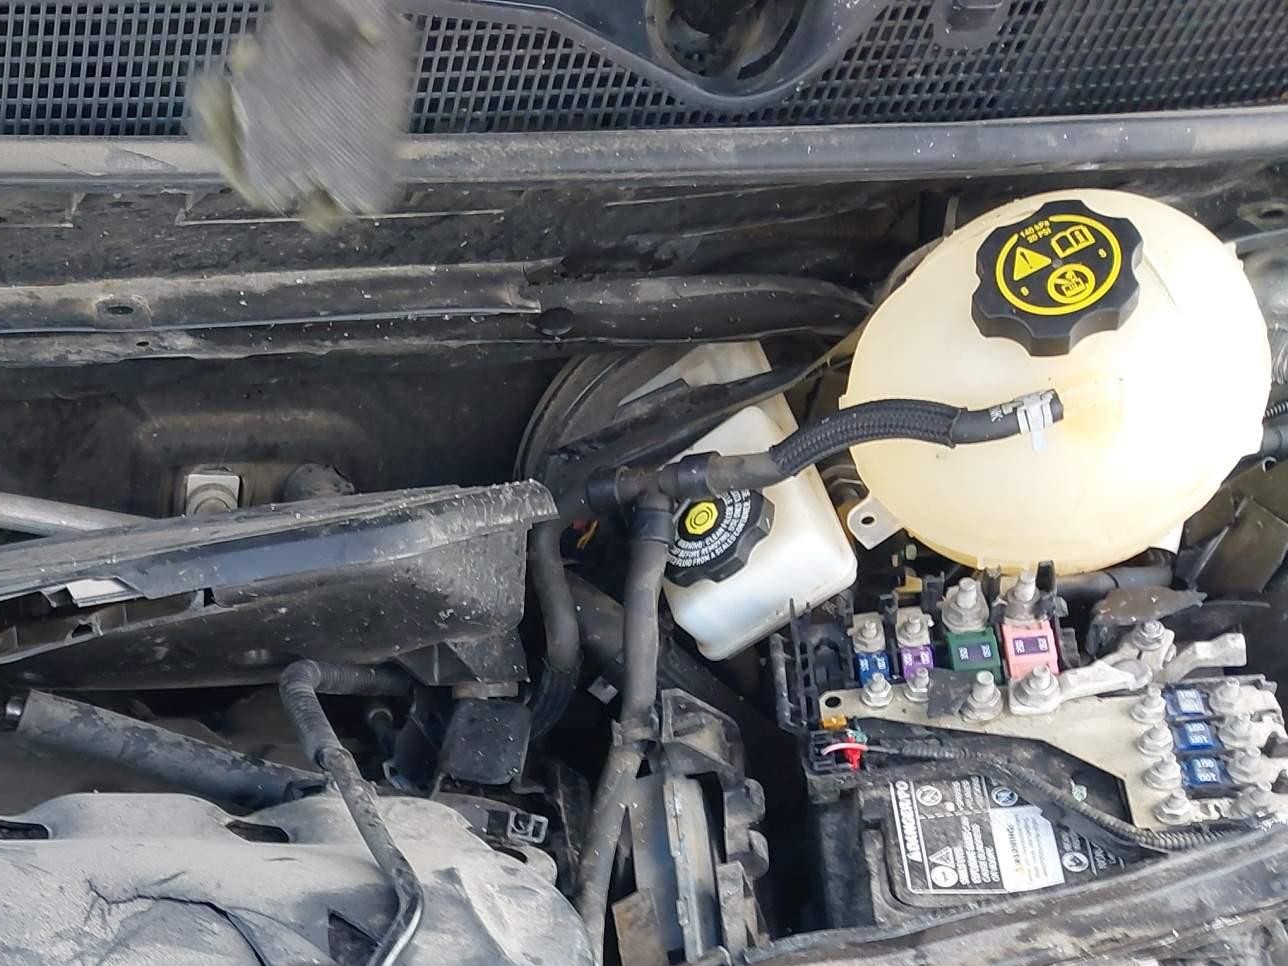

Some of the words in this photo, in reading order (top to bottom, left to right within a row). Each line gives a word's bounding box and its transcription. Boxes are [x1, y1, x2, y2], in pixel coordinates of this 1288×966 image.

[1020, 226, 1035, 238] 140
[1026, 232, 1039, 243] 20
[1037, 227, 1052, 238] PSI
